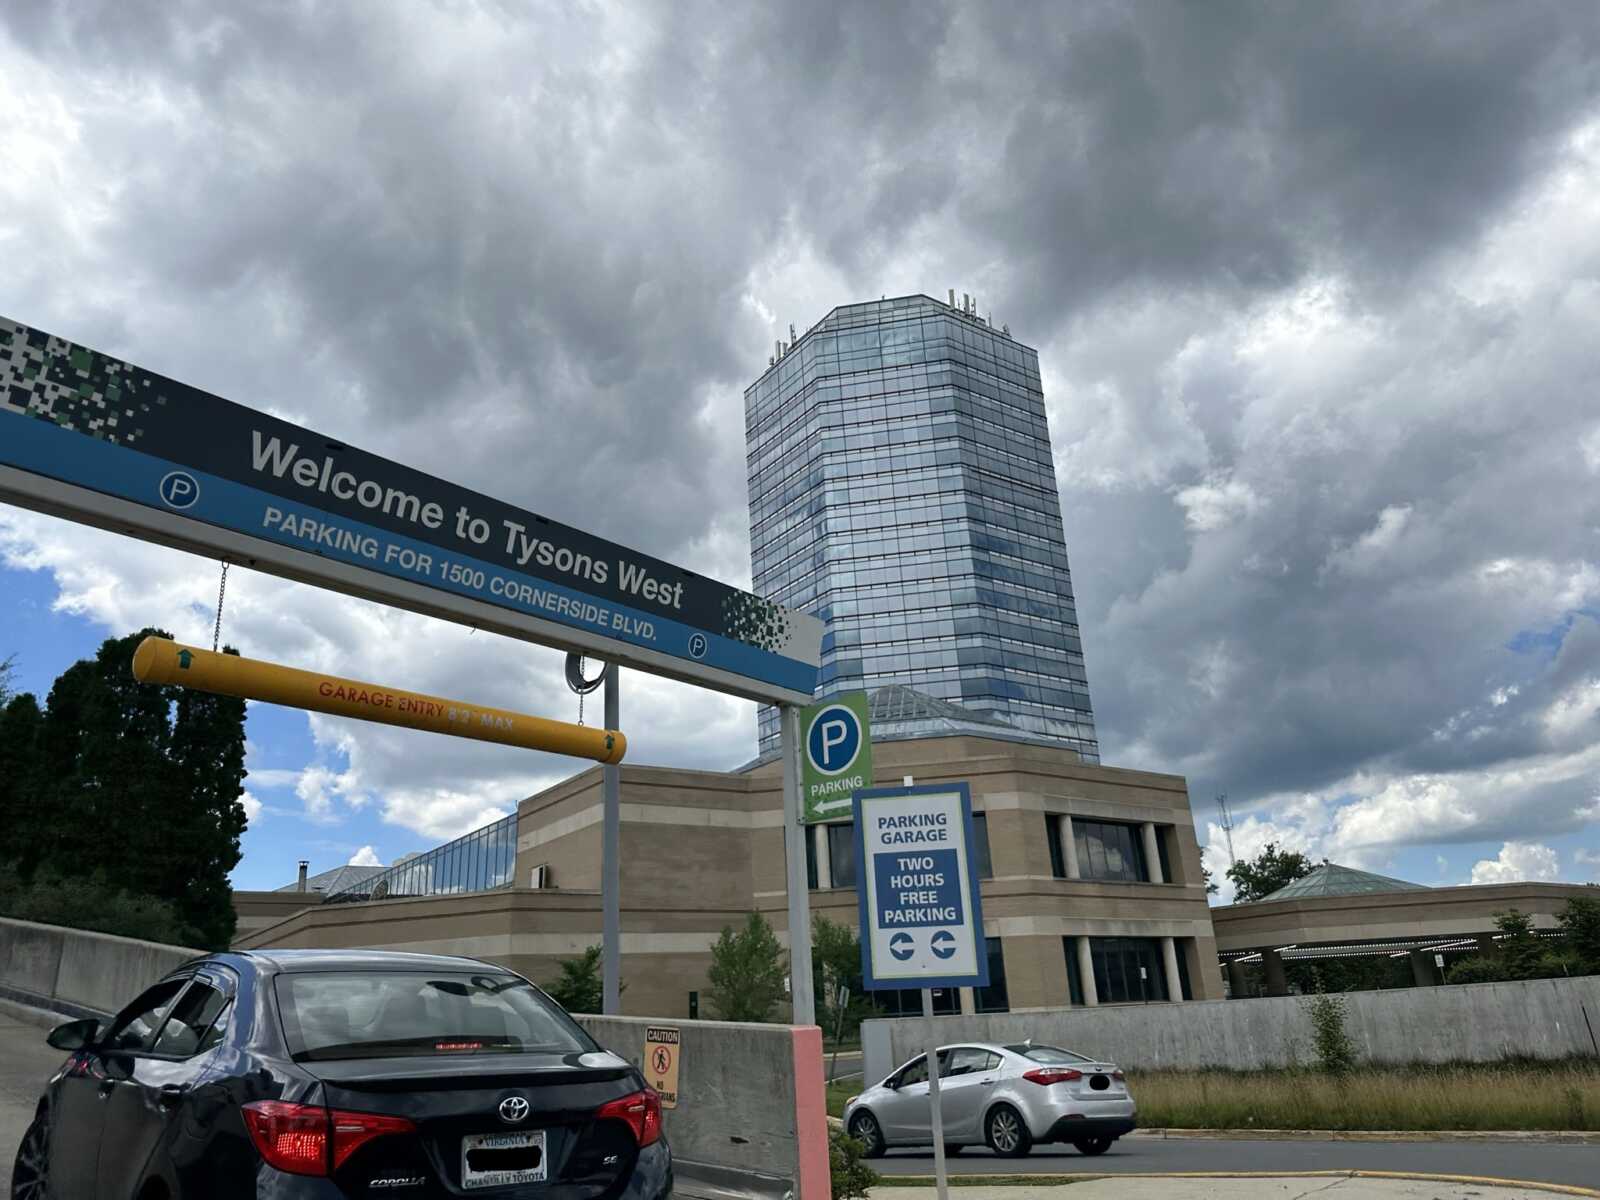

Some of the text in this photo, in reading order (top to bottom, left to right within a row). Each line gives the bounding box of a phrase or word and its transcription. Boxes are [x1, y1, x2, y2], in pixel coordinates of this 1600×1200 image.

[170, 479, 190, 500] P
[251, 429, 684, 609] Welcome to Tysons West
[262, 507, 657, 641] PARKING FOR 1500 CORNERSIDE BLVD.
[318, 682, 394, 709] GARAGE
[398, 698, 445, 718] ENTRY
[821, 719, 848, 765] P
[811, 775, 863, 797] PARKING
[878, 812, 947, 830] PARKING
[881, 829, 948, 845] GARAGE
[897, 857, 934, 872] TWO
[890, 873, 945, 889] HOURS
[900, 890, 938, 905] FREE
[884, 906, 957, 924] PARKING
[647, 1029, 679, 1043] CAUTION
[484, 1134, 529, 1147] VIRGINIA
[513, 1172, 545, 1184] TOYOTA
